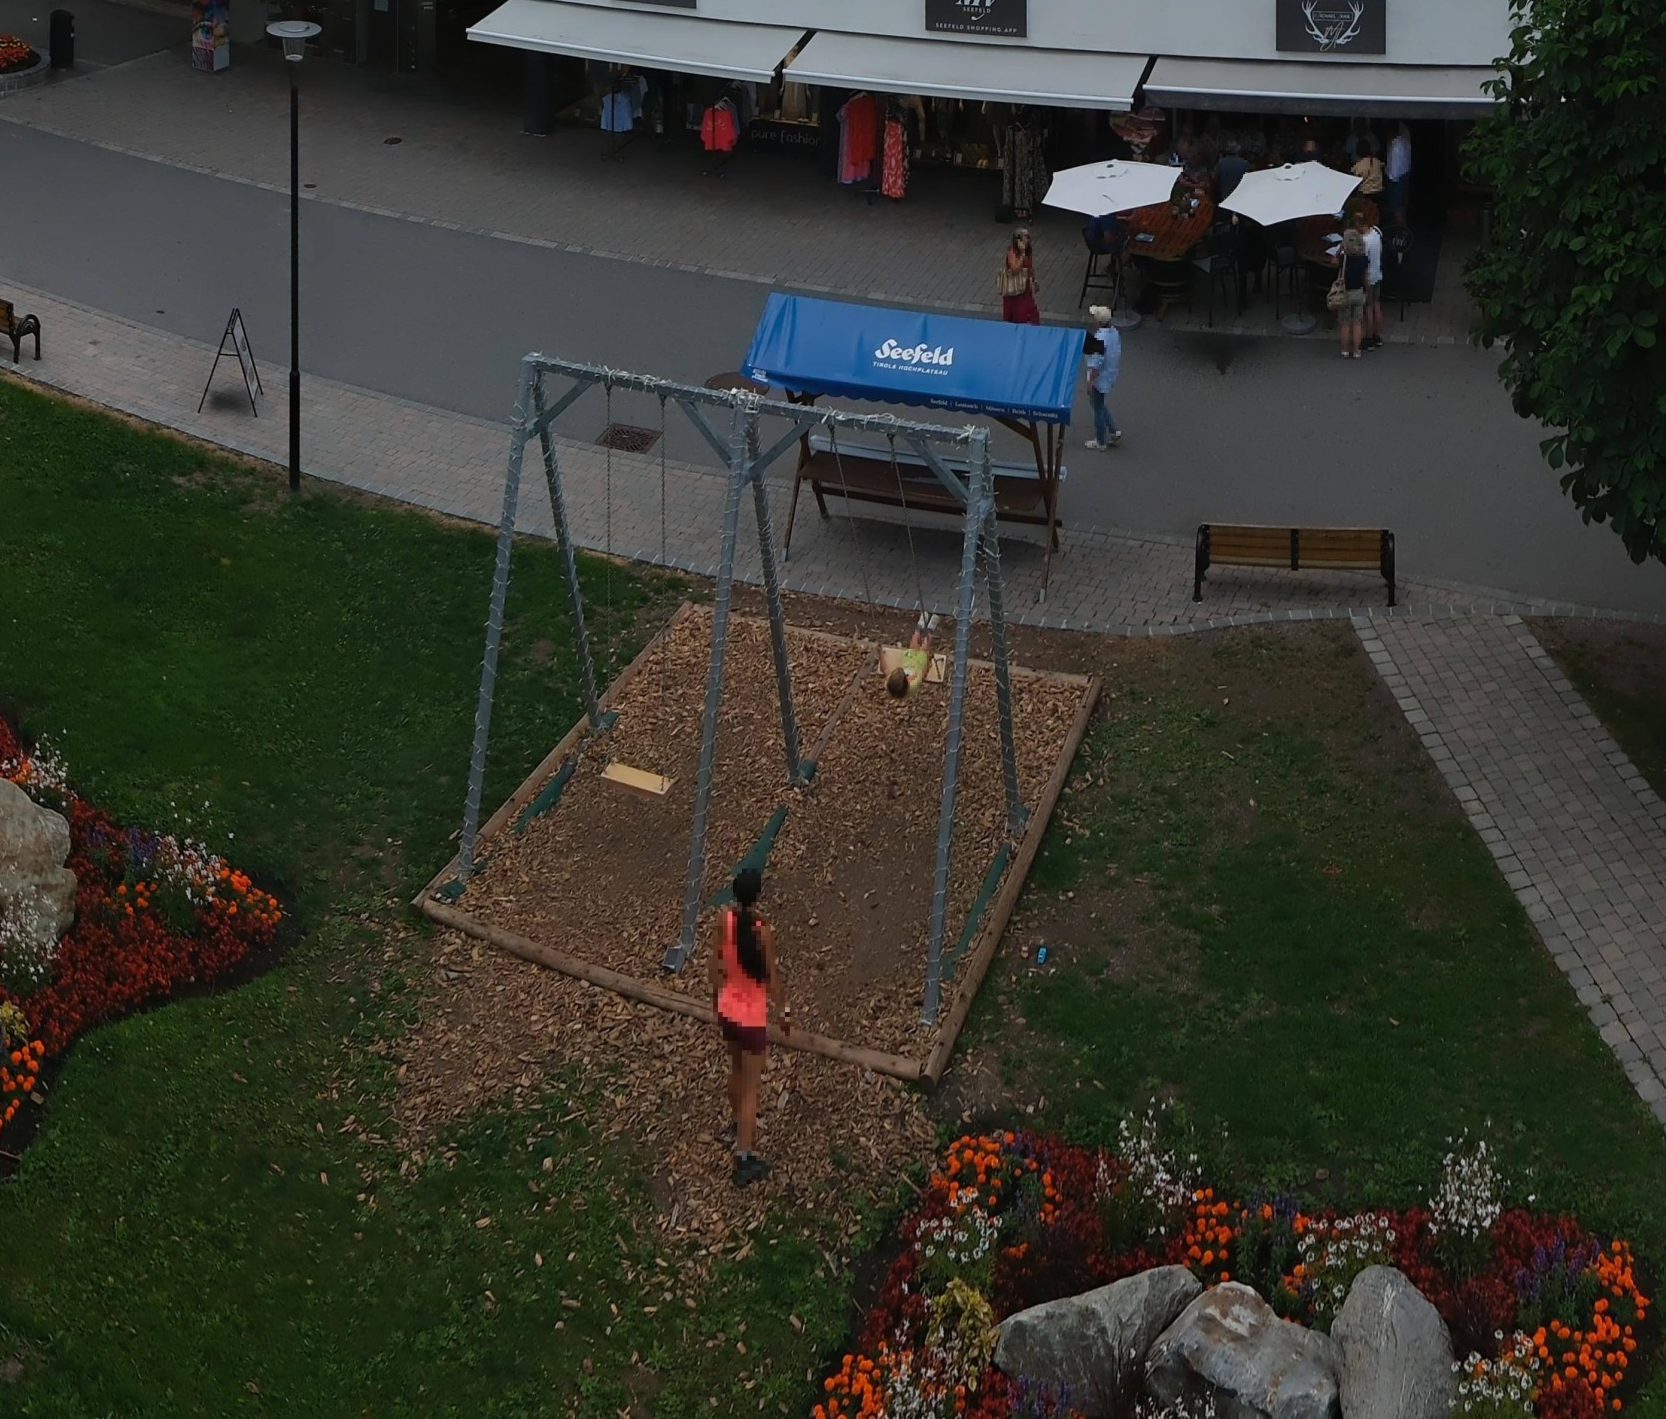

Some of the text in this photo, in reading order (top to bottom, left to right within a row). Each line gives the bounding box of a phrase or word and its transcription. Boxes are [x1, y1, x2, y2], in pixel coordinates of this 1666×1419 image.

[935, 22, 1018, 35] SEEFELD SHOPPING APP
[751, 128, 778, 143] pure
[874, 337, 955, 367] Seefeld
[872, 360, 949, 376] TIROLS HOCHPLATEAU
